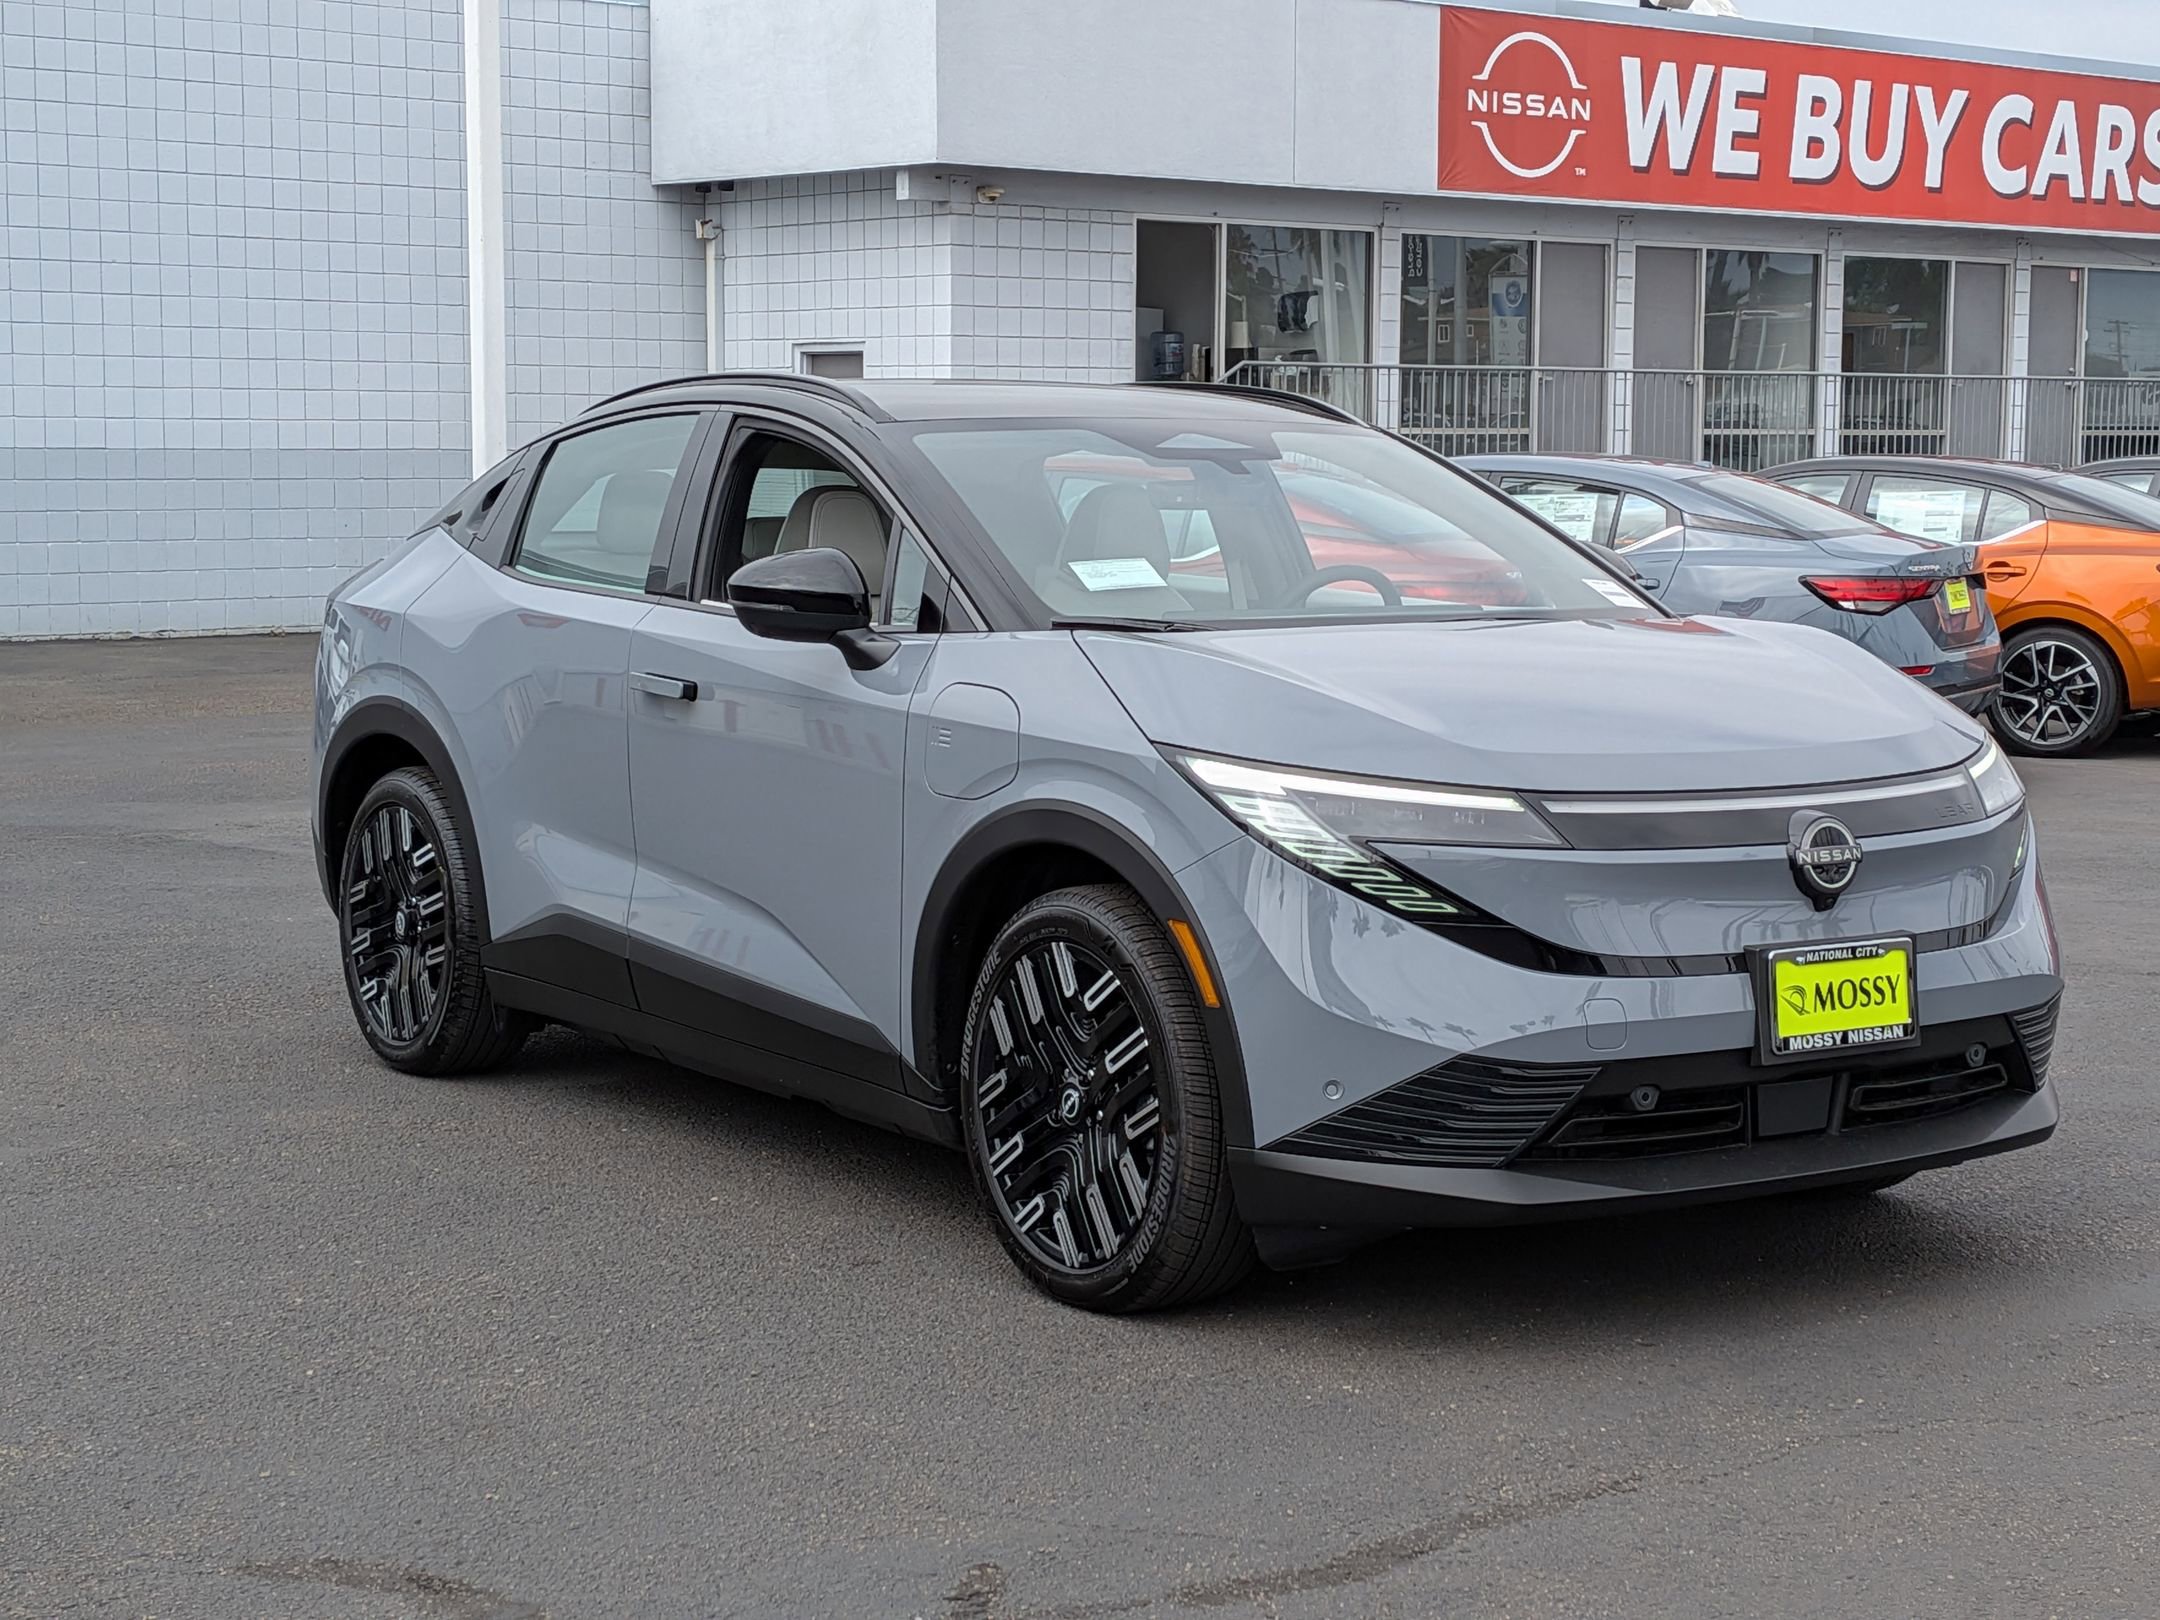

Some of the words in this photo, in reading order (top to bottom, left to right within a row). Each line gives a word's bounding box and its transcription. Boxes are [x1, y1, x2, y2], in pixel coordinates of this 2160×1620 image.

[1467, 88, 1591, 121] NISSAN
[1621, 56, 1767, 175] WE
[1789, 74, 1969, 189] BUY
[1980, 94, 2160, 206] CARS
[1799, 847, 1862, 865] NISSAN
[1806, 947, 1854, 962] NATIONAL
[1856, 946, 1878, 958] CITY
[1813, 974, 1901, 1013] MOSSY
[961, 950, 1002, 1081] BRIDGESTONE
[1789, 1031, 1843, 1050] MOSSY
[1848, 1025, 1904, 1043] NISSAN
[1130, 1134, 1181, 1273] BRIDGESTONE
